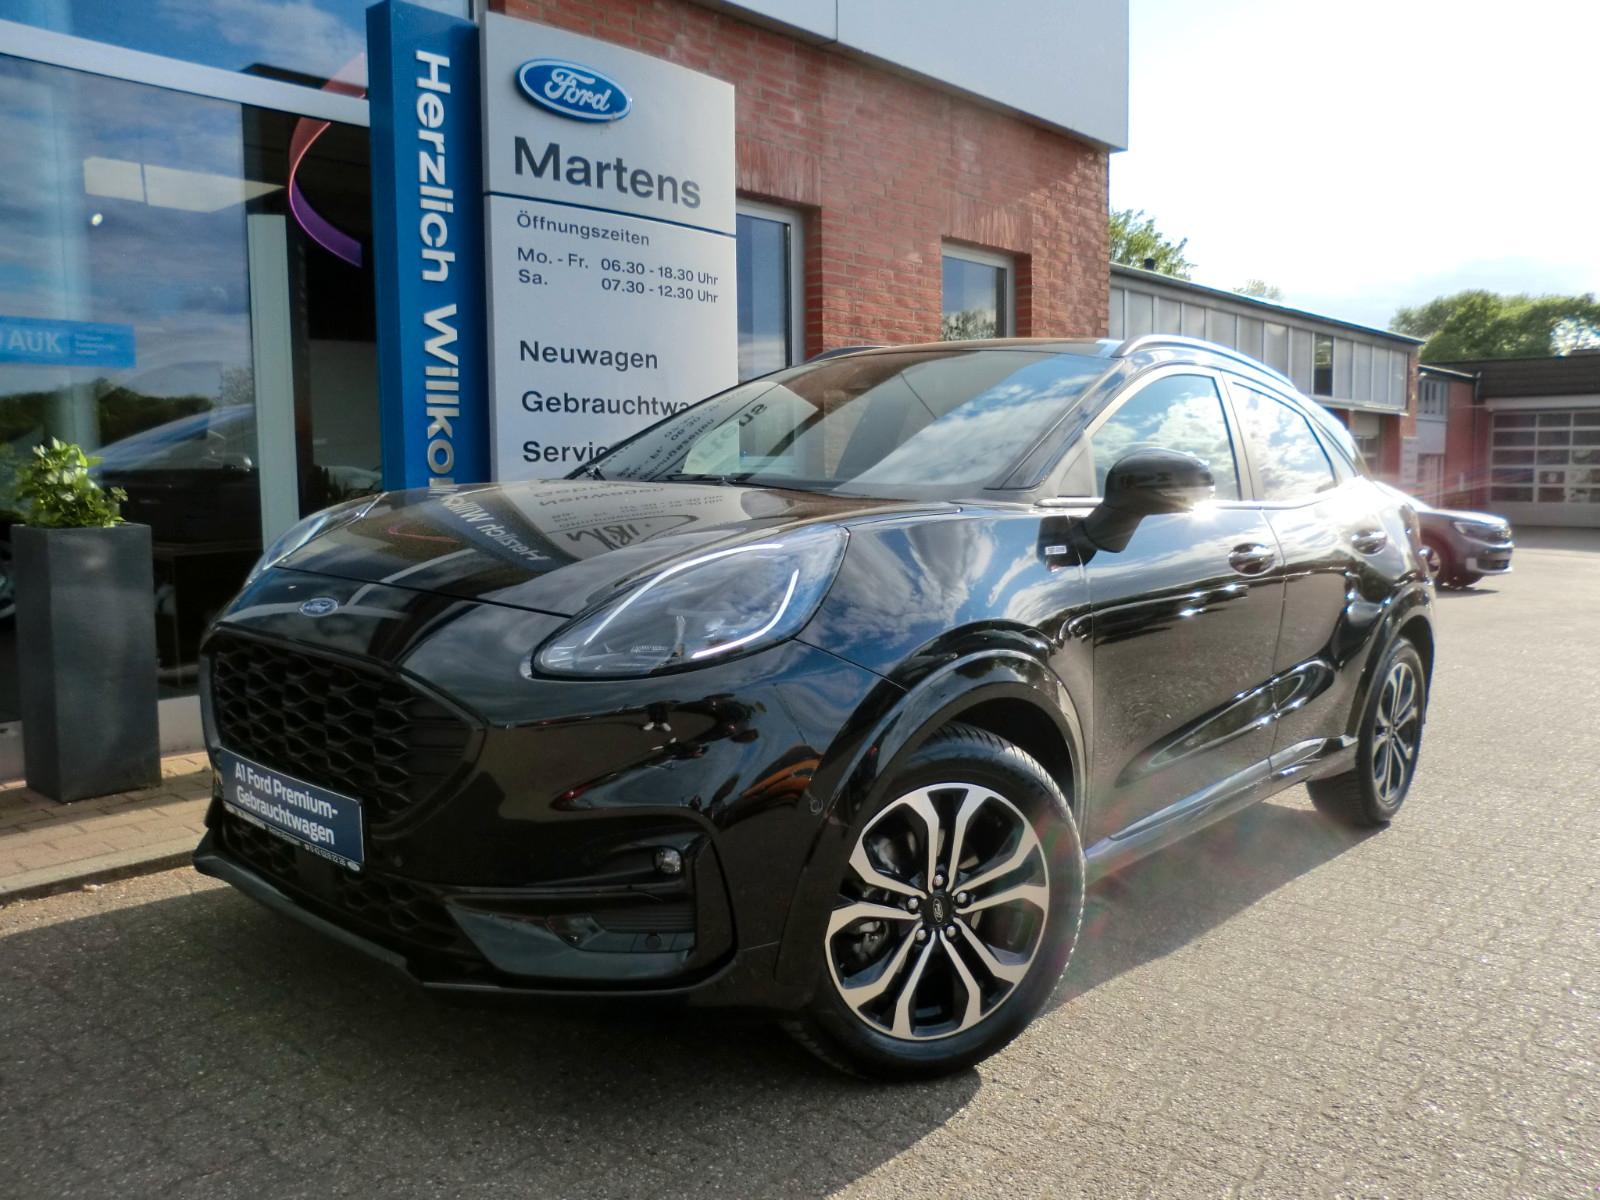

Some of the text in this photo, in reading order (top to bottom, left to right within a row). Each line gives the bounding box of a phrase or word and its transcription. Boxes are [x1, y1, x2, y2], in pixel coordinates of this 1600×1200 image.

[544, 67, 613, 112] Ford
[514, 135, 702, 208] Martens
[516, 210, 650, 246] Öffnungszeiten
[416, 49, 460, 487] Herzlich Willko
[517, 247, 553, 265] Mo.
[568, 253, 589, 269] Fr.
[600, 258, 645, 275] 06.30
[657, 266, 694, 282] 18.30
[698, 272, 719, 286] Uhr
[518, 269, 548, 285] Sa.
[601, 278, 645, 294] 07.30
[657, 285, 694, 301] 12.30
[697, 290, 719, 304] Uhr
[520, 340, 658, 372] Neuwagen
[248, 765, 272, 795] Ford
[273, 778, 338, 819] Premium-
[236, 785, 335, 845] Gebrauchtwagen
